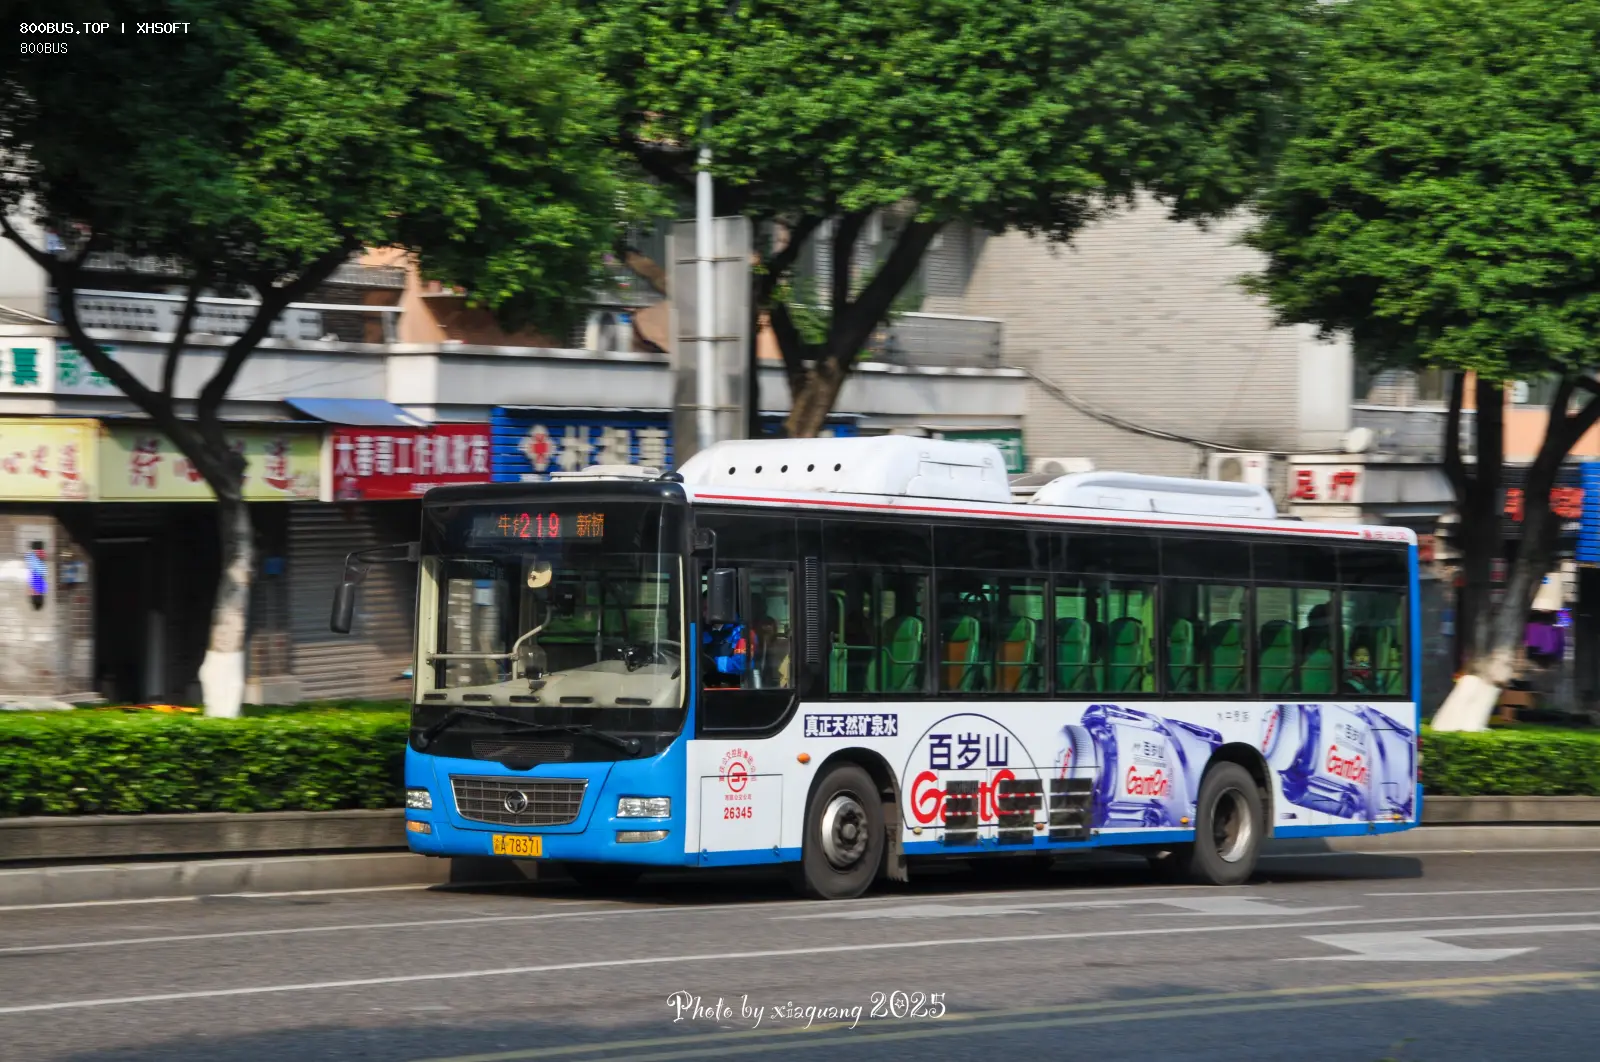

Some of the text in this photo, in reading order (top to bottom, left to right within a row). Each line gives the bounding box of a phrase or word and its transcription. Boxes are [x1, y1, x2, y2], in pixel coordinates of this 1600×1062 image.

[519, 512, 560, 538] 219
[576, 512, 604, 537] 新桥
[805, 715, 897, 737] 真正天然矿泉水
[928, 732, 1009, 770] 百岁山
[723, 806, 753, 820] 26345
